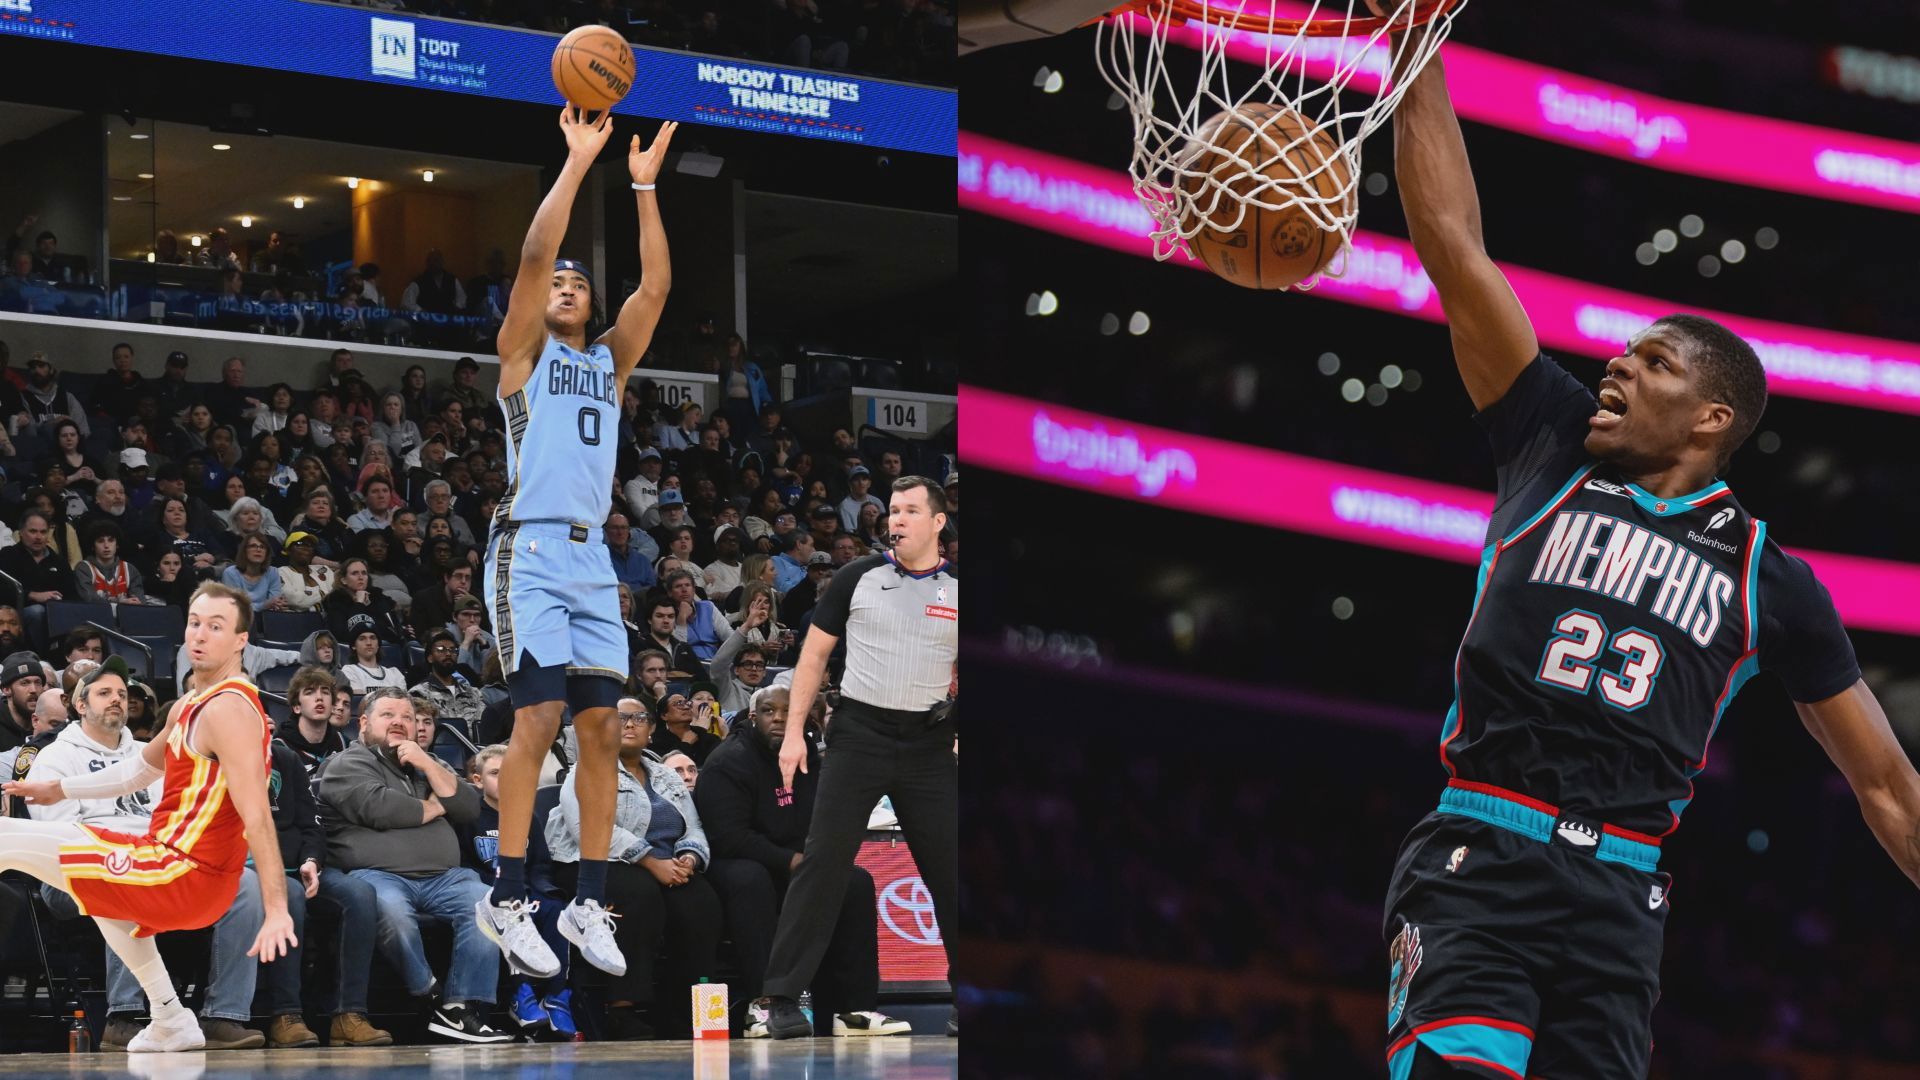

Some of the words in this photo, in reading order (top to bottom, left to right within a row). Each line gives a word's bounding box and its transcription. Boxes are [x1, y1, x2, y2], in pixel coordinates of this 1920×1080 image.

[379, 33, 408, 56] TN
[419, 37, 460, 58] TDOT
[698, 62, 776, 90] NOBODY
[779, 73, 860, 102] TRASHES
[728, 86, 831, 118] TENNESSEE
[548, 359, 616, 409] GRIZZLIE
[656, 384, 692, 409] 105
[577, 406, 601, 447] 0
[883, 403, 917, 428] 104
[1687, 530, 1738, 555] Robinhood
[1527, 509, 1736, 649] MEMPHIS
[1535, 607, 1666, 713] 23
